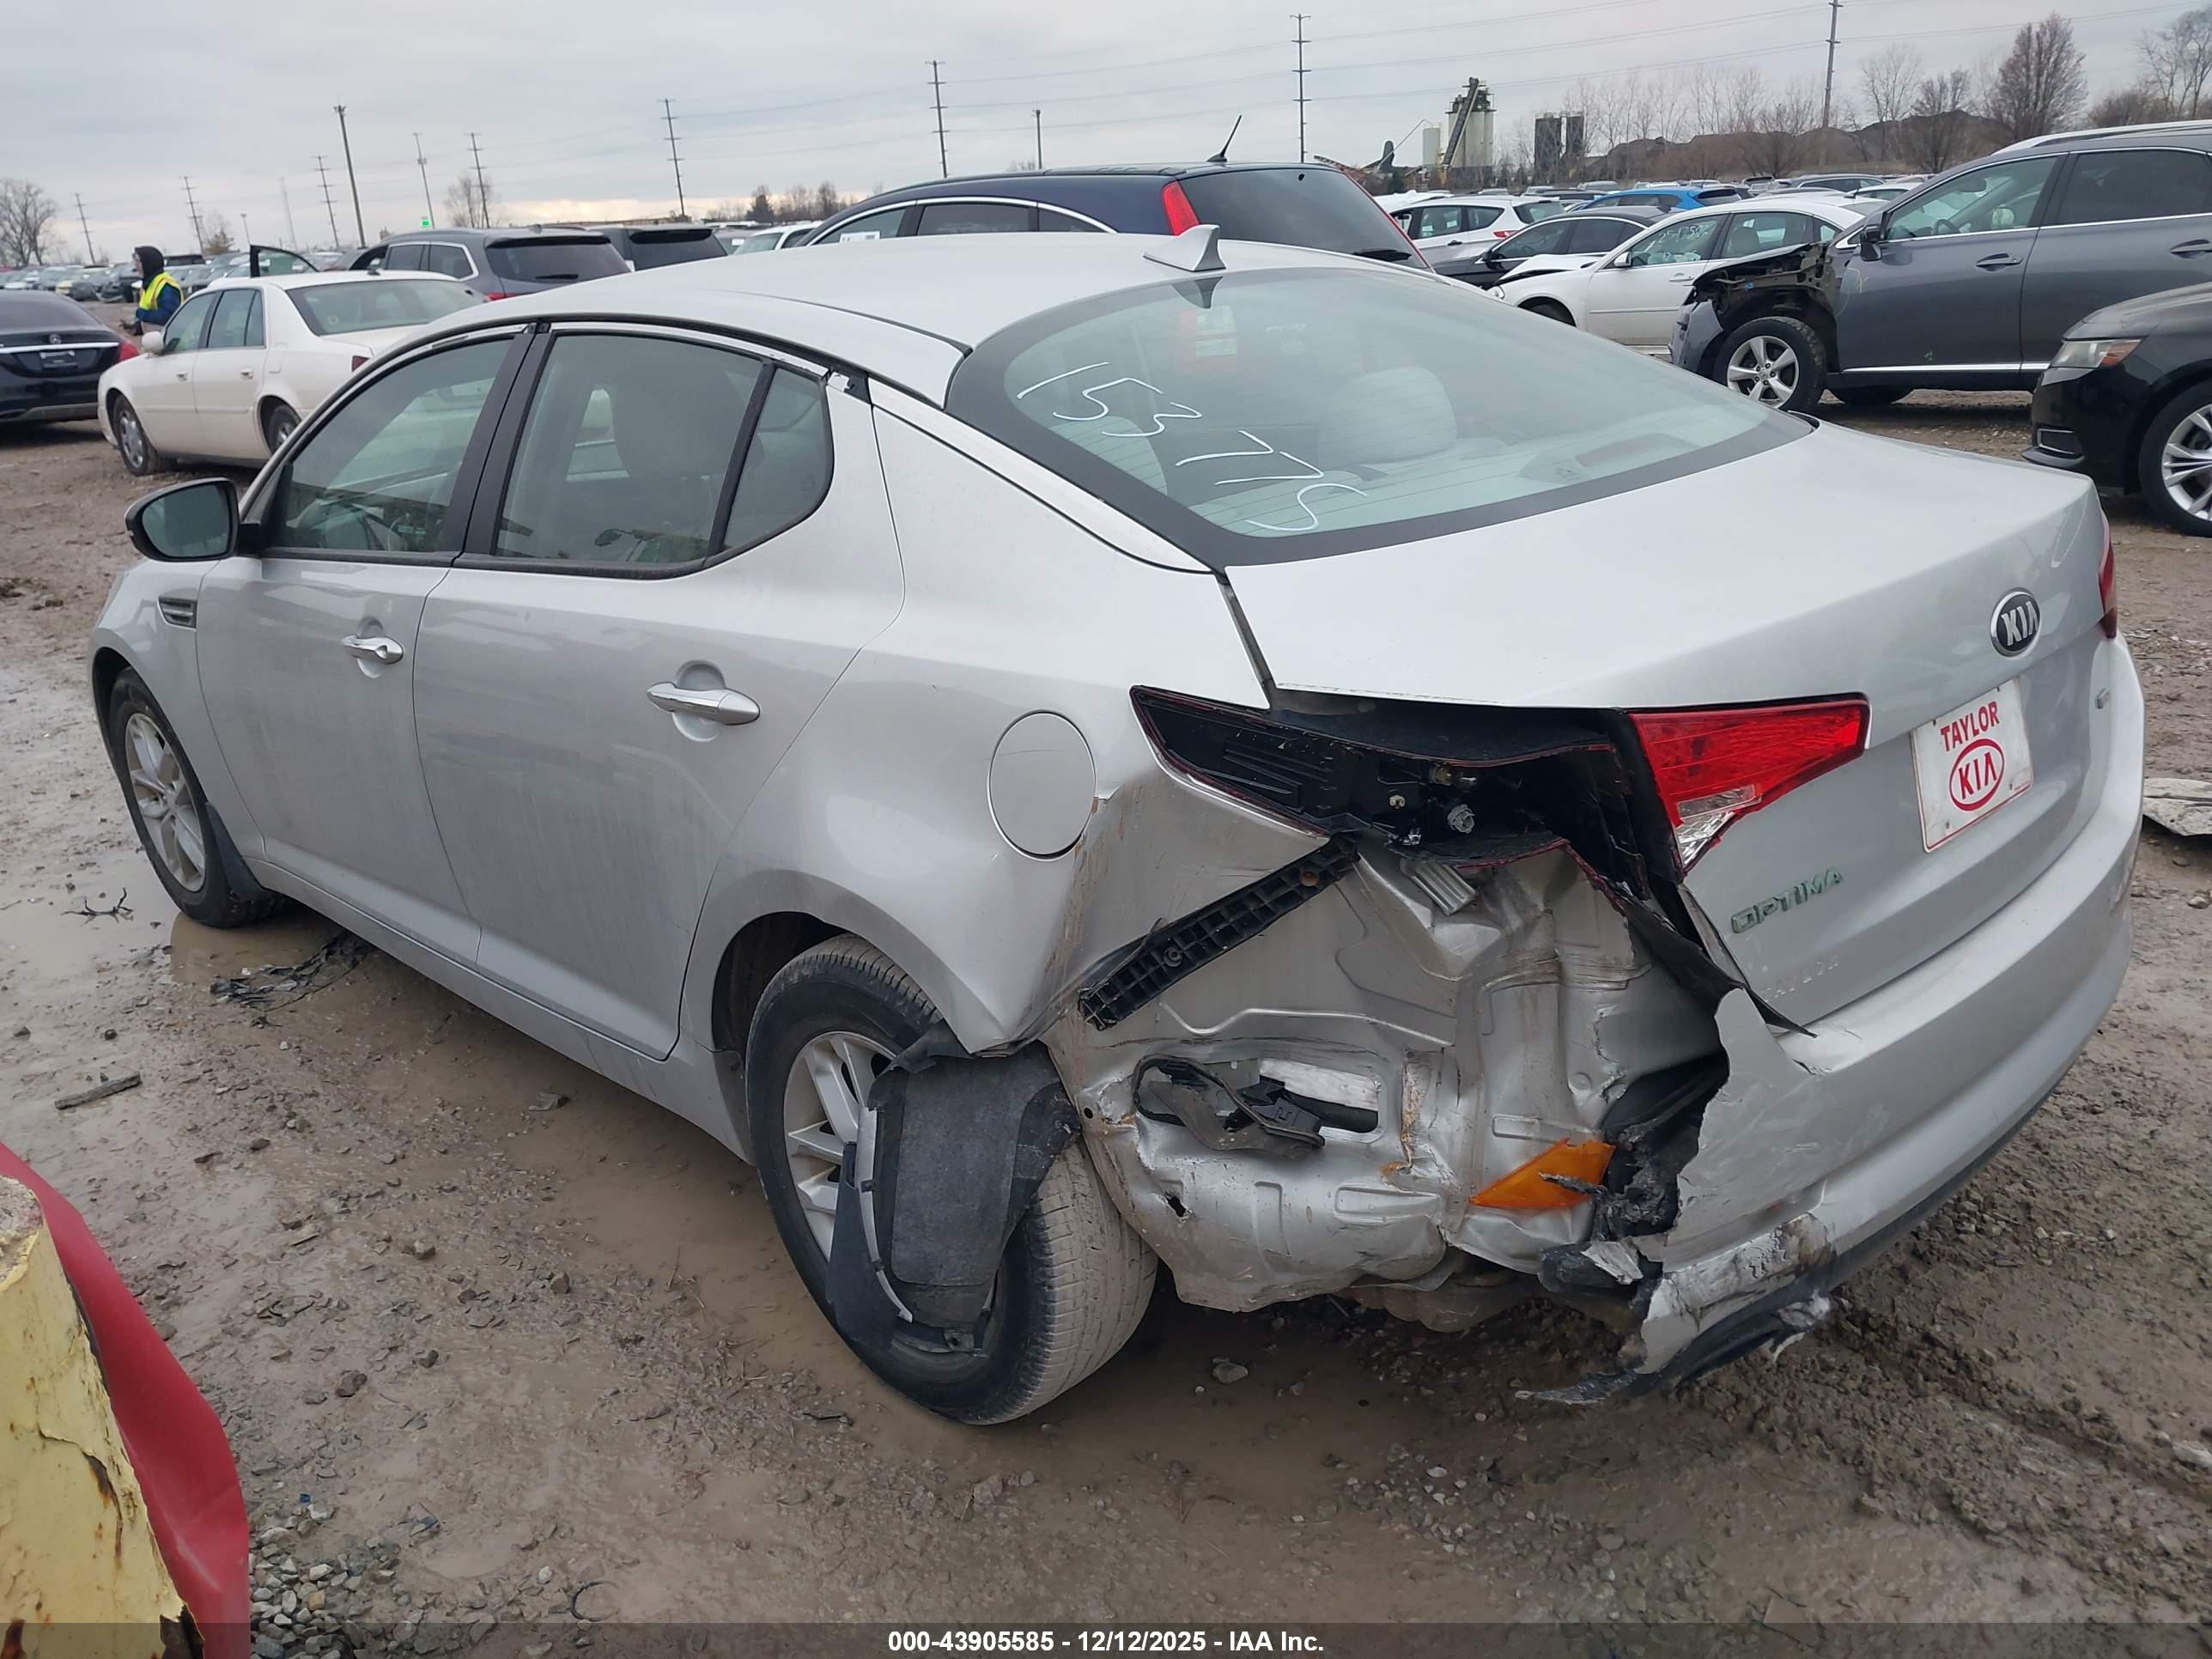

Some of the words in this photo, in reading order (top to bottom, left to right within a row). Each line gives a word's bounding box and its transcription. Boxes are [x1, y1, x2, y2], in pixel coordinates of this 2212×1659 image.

[2001, 600, 2039, 647] KIA
[1940, 700, 2000, 752] TAYLOR
[1957, 751, 1998, 800] KIA
[1730, 866, 1843, 934] OPTIMA
